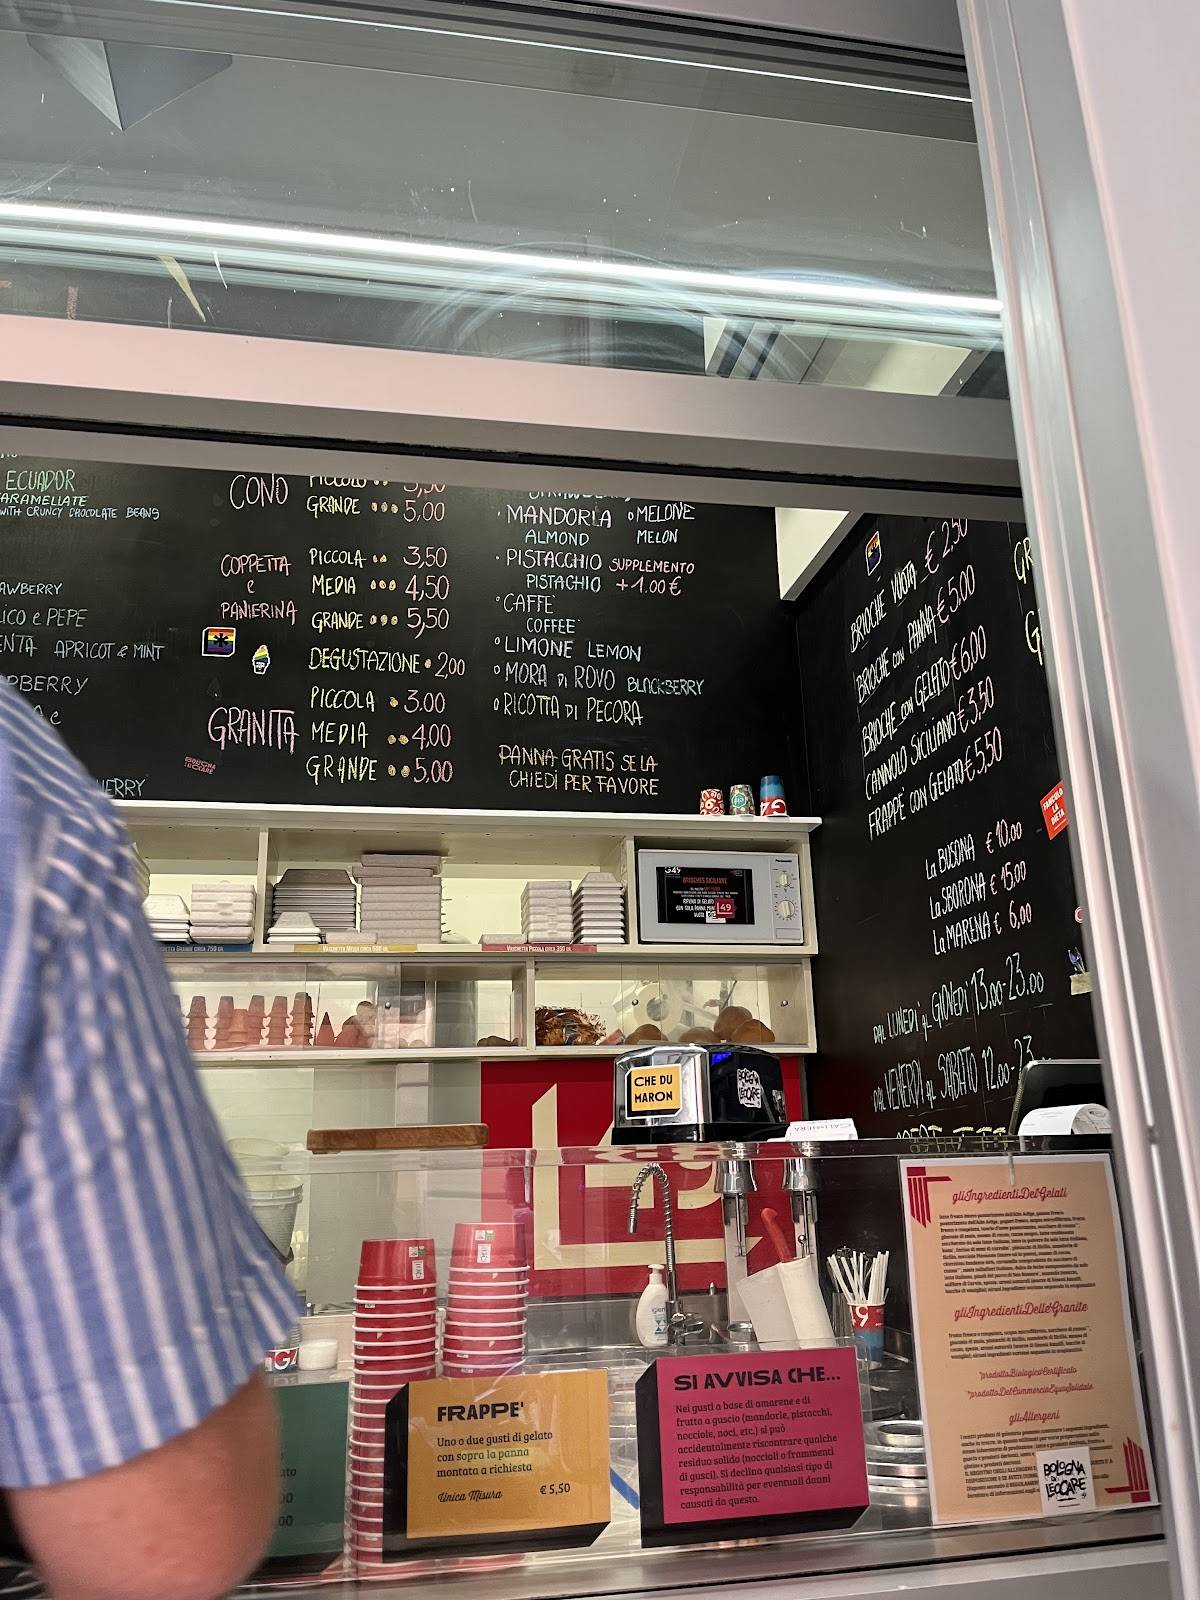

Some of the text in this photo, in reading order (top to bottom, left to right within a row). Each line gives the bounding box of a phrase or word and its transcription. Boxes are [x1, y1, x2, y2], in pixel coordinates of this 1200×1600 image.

[6, 469, 75, 492] ECUADOR
[230, 473, 289, 509] CONO
[26, 506, 63, 519] CRUNCY
[69, 508, 118, 521] CHOCOLATE
[126, 507, 160, 521] BEANS
[306, 496, 361, 518] GRANDE
[507, 506, 612, 529] MANDORLA
[636, 502, 695, 523] MELONE
[525, 529, 590, 547] ALMOND
[637, 529, 678, 545] MELON
[220, 553, 292, 577] COPPETTA
[309, 546, 447, 569] PICCOLA 3,50
[506, 549, 695, 575] PISTACCHIO SUPPLEMENTO
[312, 574, 450, 601] MEDIA 4,50
[526, 574, 601, 593] PISTACHIO
[46, 608, 89, 627] PEPE
[221, 600, 298, 626] PANIERINA
[850, 560, 917, 654] BRIOCHE VUOTA
[312, 607, 450, 639] GRANDE 5,50
[526, 617, 576, 634] COFFEE
[54, 639, 115, 660] APRICOT
[133, 643, 165, 661] MINT
[308, 647, 421, 674] DEGUSTAZIONE
[504, 636, 641, 663] LIMONE LEMON
[856, 604, 937, 704] BRIOCHE PANNA
[504, 662, 548, 688] MORA
[574, 664, 616, 691] ROVO
[627, 676, 704, 696] BLACKBERRY
[310, 685, 376, 712] PICCOLA
[504, 692, 560, 720] RICOTTA
[587, 697, 643, 726] PECORA
[862, 656, 951, 757] BRIOCHE GELATO
[208, 706, 300, 755] GRANITA
[312, 721, 368, 749] MEDIA
[499, 745, 558, 768] PANNA
[561, 749, 615, 773] GRATIS
[865, 711, 958, 801] CANNOLO SICILIANO
[306, 754, 378, 785] GRANDE
[928, 758, 964, 802] GELATO
[565, 774, 592, 793] PER
[595, 775, 659, 796] FAVORE
[938, 833, 975, 873] BUSONA
[941, 871, 986, 914] SBORONA
[945, 911, 991, 950] MARENA
[634, 1074, 673, 1088] CHE DU
[938, 1046, 978, 1102] SABATO
[634, 1091, 673, 1104] MARON
[674, 1366, 841, 1391] SI AVVISA CHE...
[676, 1403, 691, 1413] Nei
[692, 1402, 714, 1414] gusti
[723, 1401, 743, 1410] base
[745, 1399, 753, 1408] di
[755, 1398, 794, 1408] amarene
[802, 1396, 811, 1404] di
[712, 1415, 740, 1426] guscio
[760, 1425, 768, 1434] si
[437, 1431, 553, 1448] Uno o due gusti di gelato
[678, 1434, 838, 1454] accidentalmente riscontrare qualche
[437, 1448, 529, 1465] con sopra la panna
[679, 1456, 712, 1468] residuo
[713, 1454, 740, 1466] solido
[787, 1447, 834, 1460] frammenti
[1043, 1459, 1086, 1477] BOLOGNA
[437, 1462, 532, 1478] montata a richiesta
[730, 1466, 763, 1477] declina
[764, 1463, 804, 1476] qualsiasi
[806, 1462, 822, 1474] tipo
[438, 1482, 571, 1503] Unica Misura € 5,50
[746, 1481, 761, 1493] per
[763, 1477, 804, 1489] eventuali
[806, 1474, 831, 1486] danni
[1045, 1478, 1087, 1499] LECCARE
[680, 1498, 714, 1510] causati
